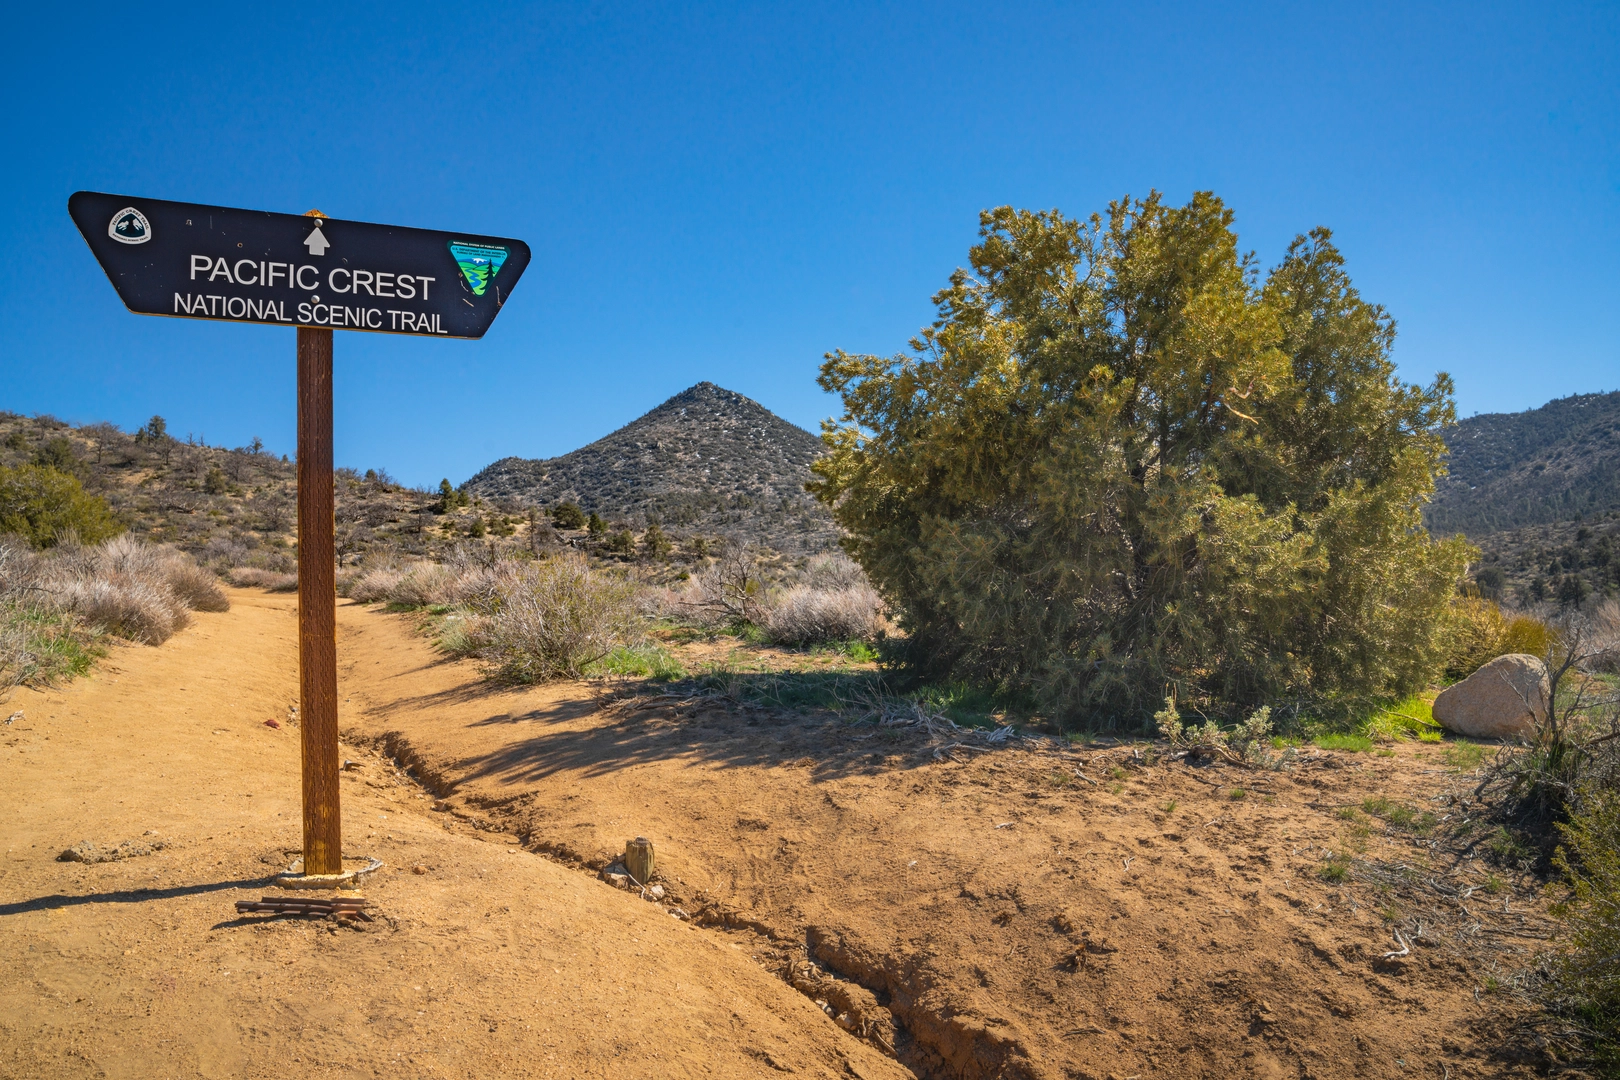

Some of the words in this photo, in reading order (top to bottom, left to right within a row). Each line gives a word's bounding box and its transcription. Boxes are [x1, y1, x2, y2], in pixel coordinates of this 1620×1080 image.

[190, 254, 320, 291] PACIFIC
[328, 268, 436, 301] CREST
[174, 292, 292, 322] NATIONAL
[297, 302, 382, 329] SCENIC
[387, 309, 448, 334] TRAIL
